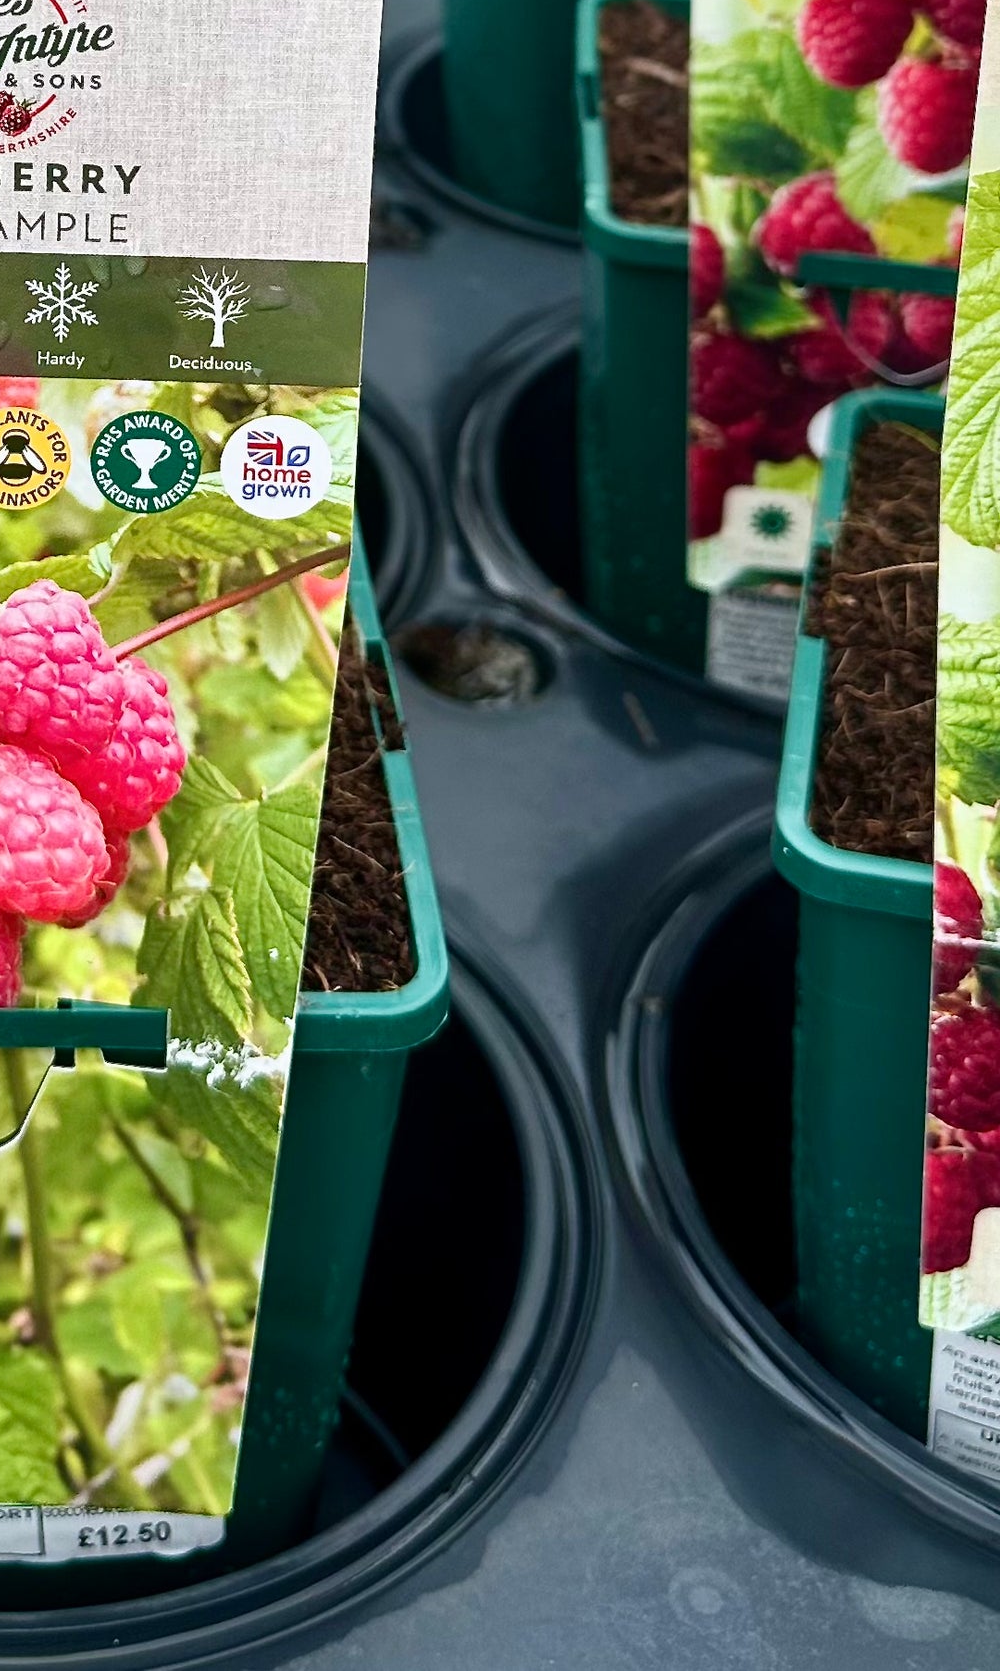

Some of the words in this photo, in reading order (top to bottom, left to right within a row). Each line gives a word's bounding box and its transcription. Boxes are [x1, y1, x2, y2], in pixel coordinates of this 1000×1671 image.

[4, 74, 18, 88] &
[33, 73, 102, 90] SONS
[37, 350, 86, 371] Hardy
[169, 353, 253, 373] Deciduous
[46, 432, 68, 463] FOR
[96, 425, 124, 458] RHS
[124, 414, 185, 443] AWARD
[179, 440, 198, 461] OF
[243, 463, 312, 484] home
[96, 468, 149, 511] GARDEN
[153, 470, 198, 510] MERIT
[242, 483, 312, 500] grown
[78, 1520, 172, 1547] £12.50
